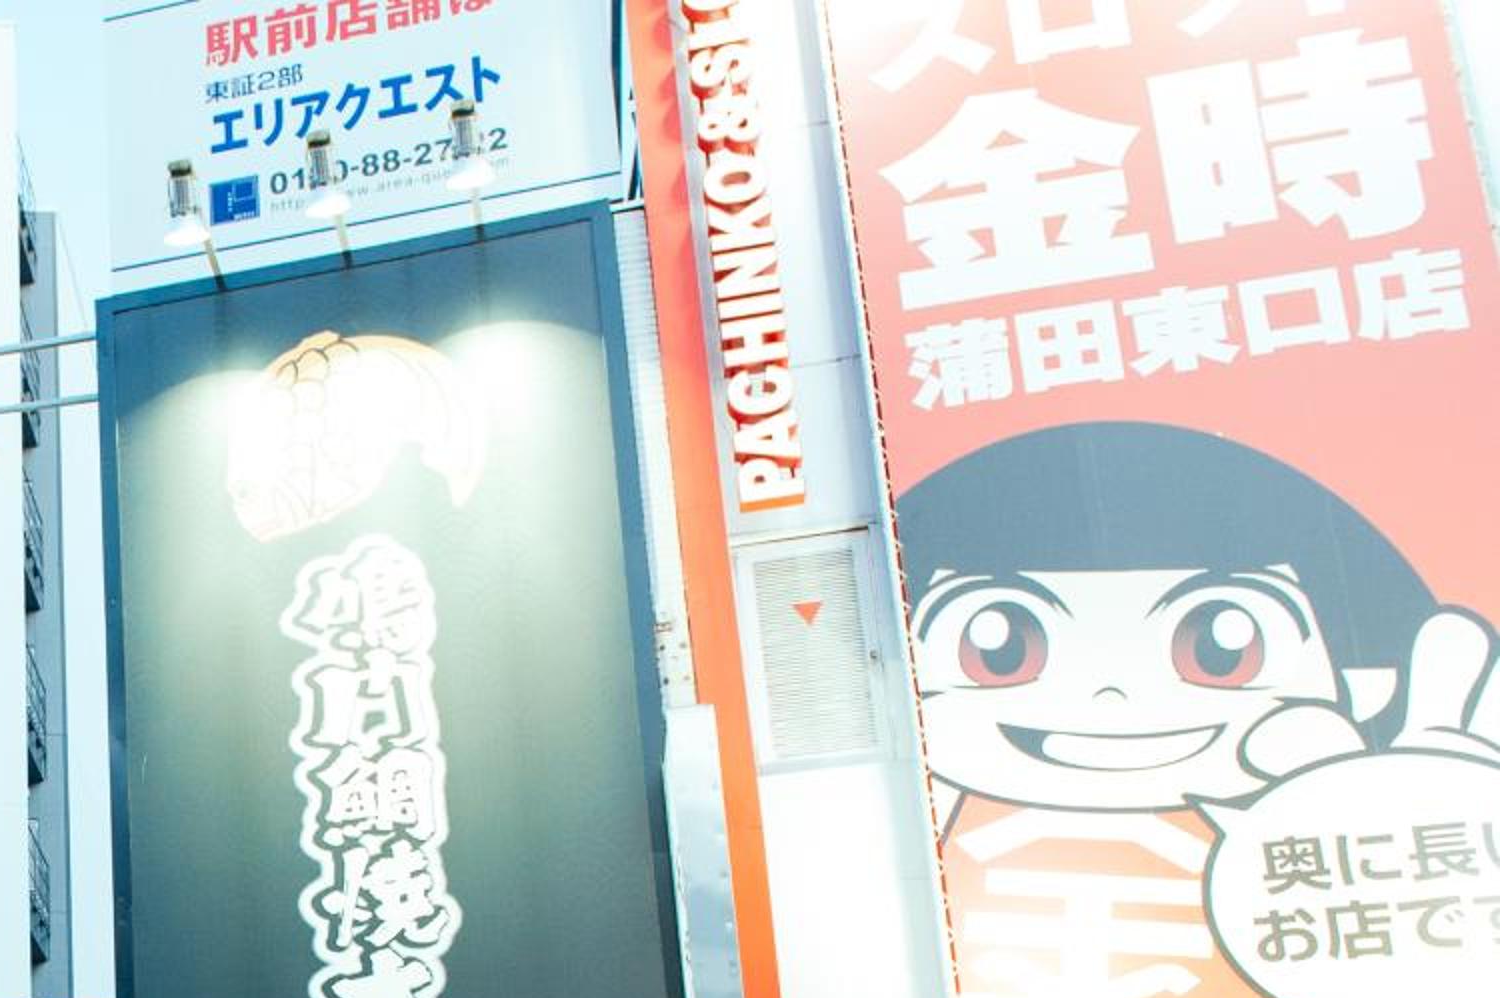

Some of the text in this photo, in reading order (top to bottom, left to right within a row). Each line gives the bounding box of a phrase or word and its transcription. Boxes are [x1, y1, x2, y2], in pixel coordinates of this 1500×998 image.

[206, 0, 493, 66] 駅前店舗
[204, 64, 304, 104] 東証2部
[210, 55, 501, 154] エリアクエスト
[878, 28, 1435, 310] 金時
[904, 247, 1472, 411] 蒲田東口店
